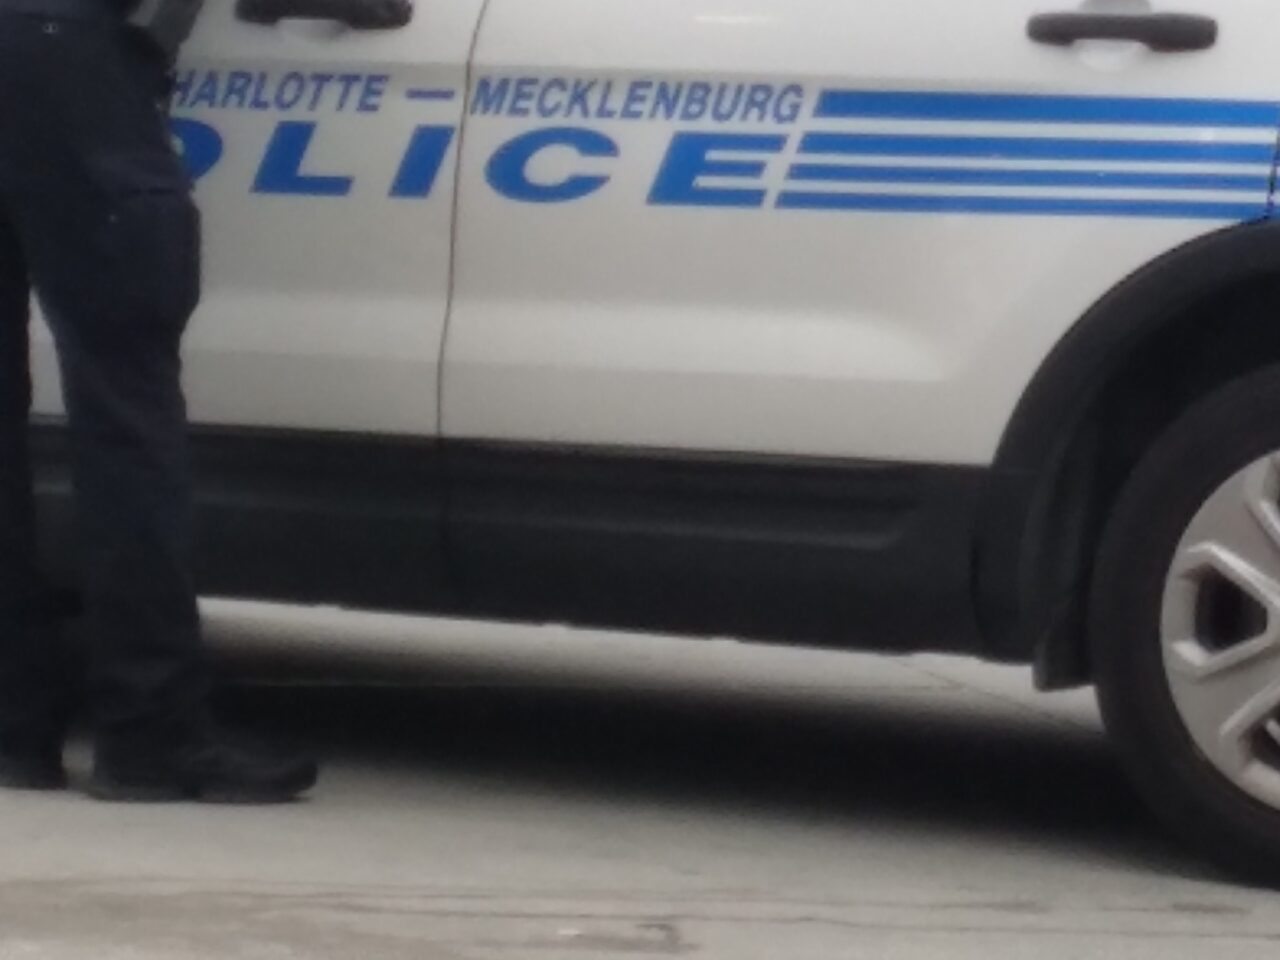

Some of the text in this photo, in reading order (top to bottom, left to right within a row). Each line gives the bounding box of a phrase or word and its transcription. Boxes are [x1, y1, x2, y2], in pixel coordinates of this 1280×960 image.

[174, 70, 390, 113] HARLOTTE
[470, 75, 803, 125] MECKLENBURG
[168, 117, 788, 208] LICE
